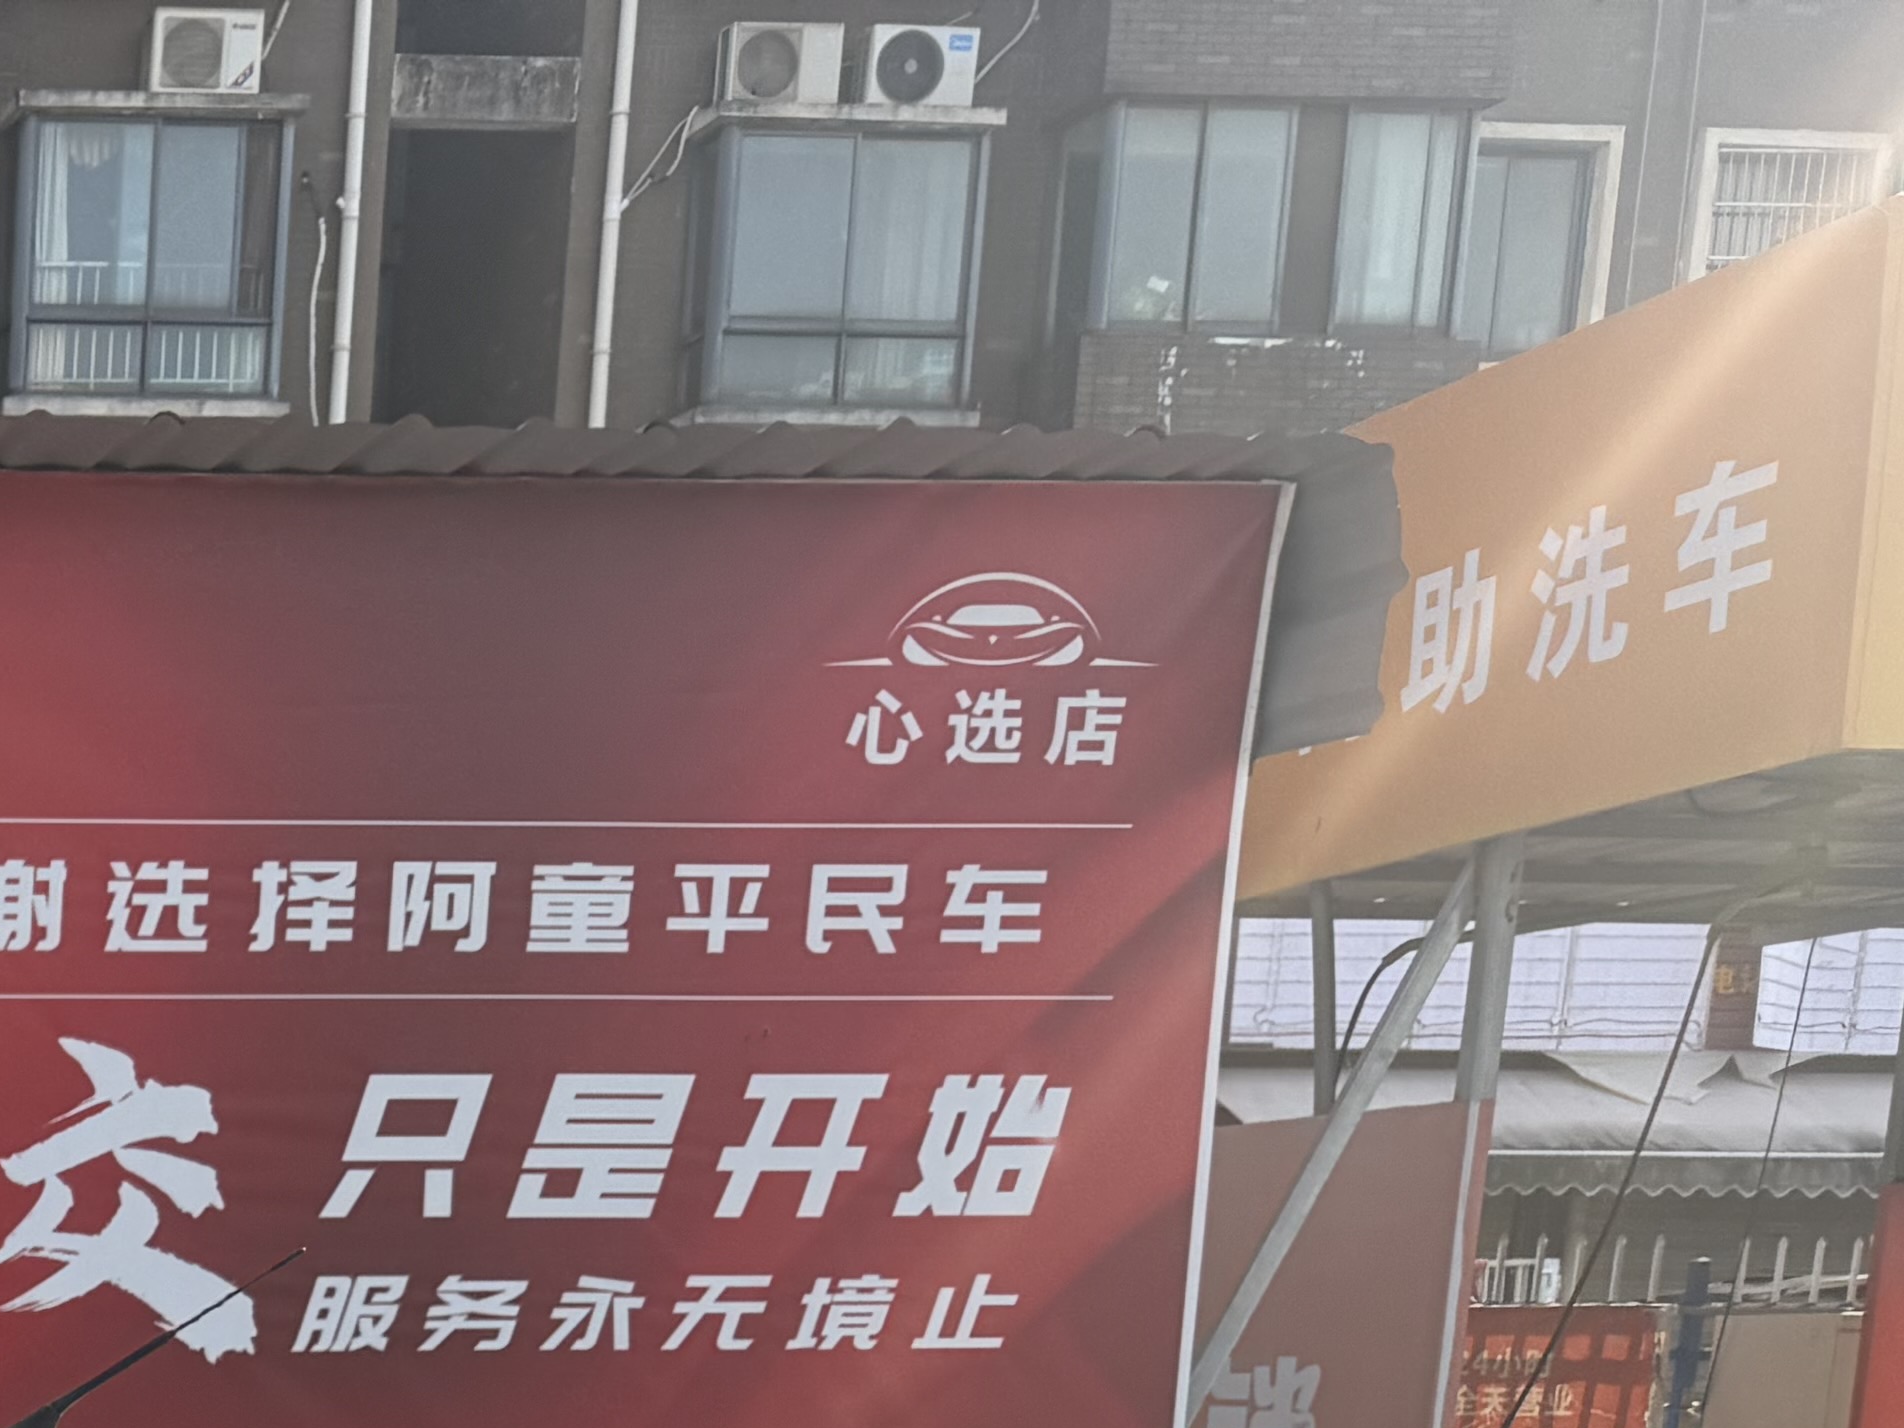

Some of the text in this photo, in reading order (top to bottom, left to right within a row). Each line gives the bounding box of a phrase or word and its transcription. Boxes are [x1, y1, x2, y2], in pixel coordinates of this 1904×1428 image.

[1400, 460, 1779, 714] 助洗车
[846, 688, 1126, 768] 心选店
[319, 1073, 1073, 1220] 只是开始
[291, 1273, 1019, 1352] 服务永无境止
